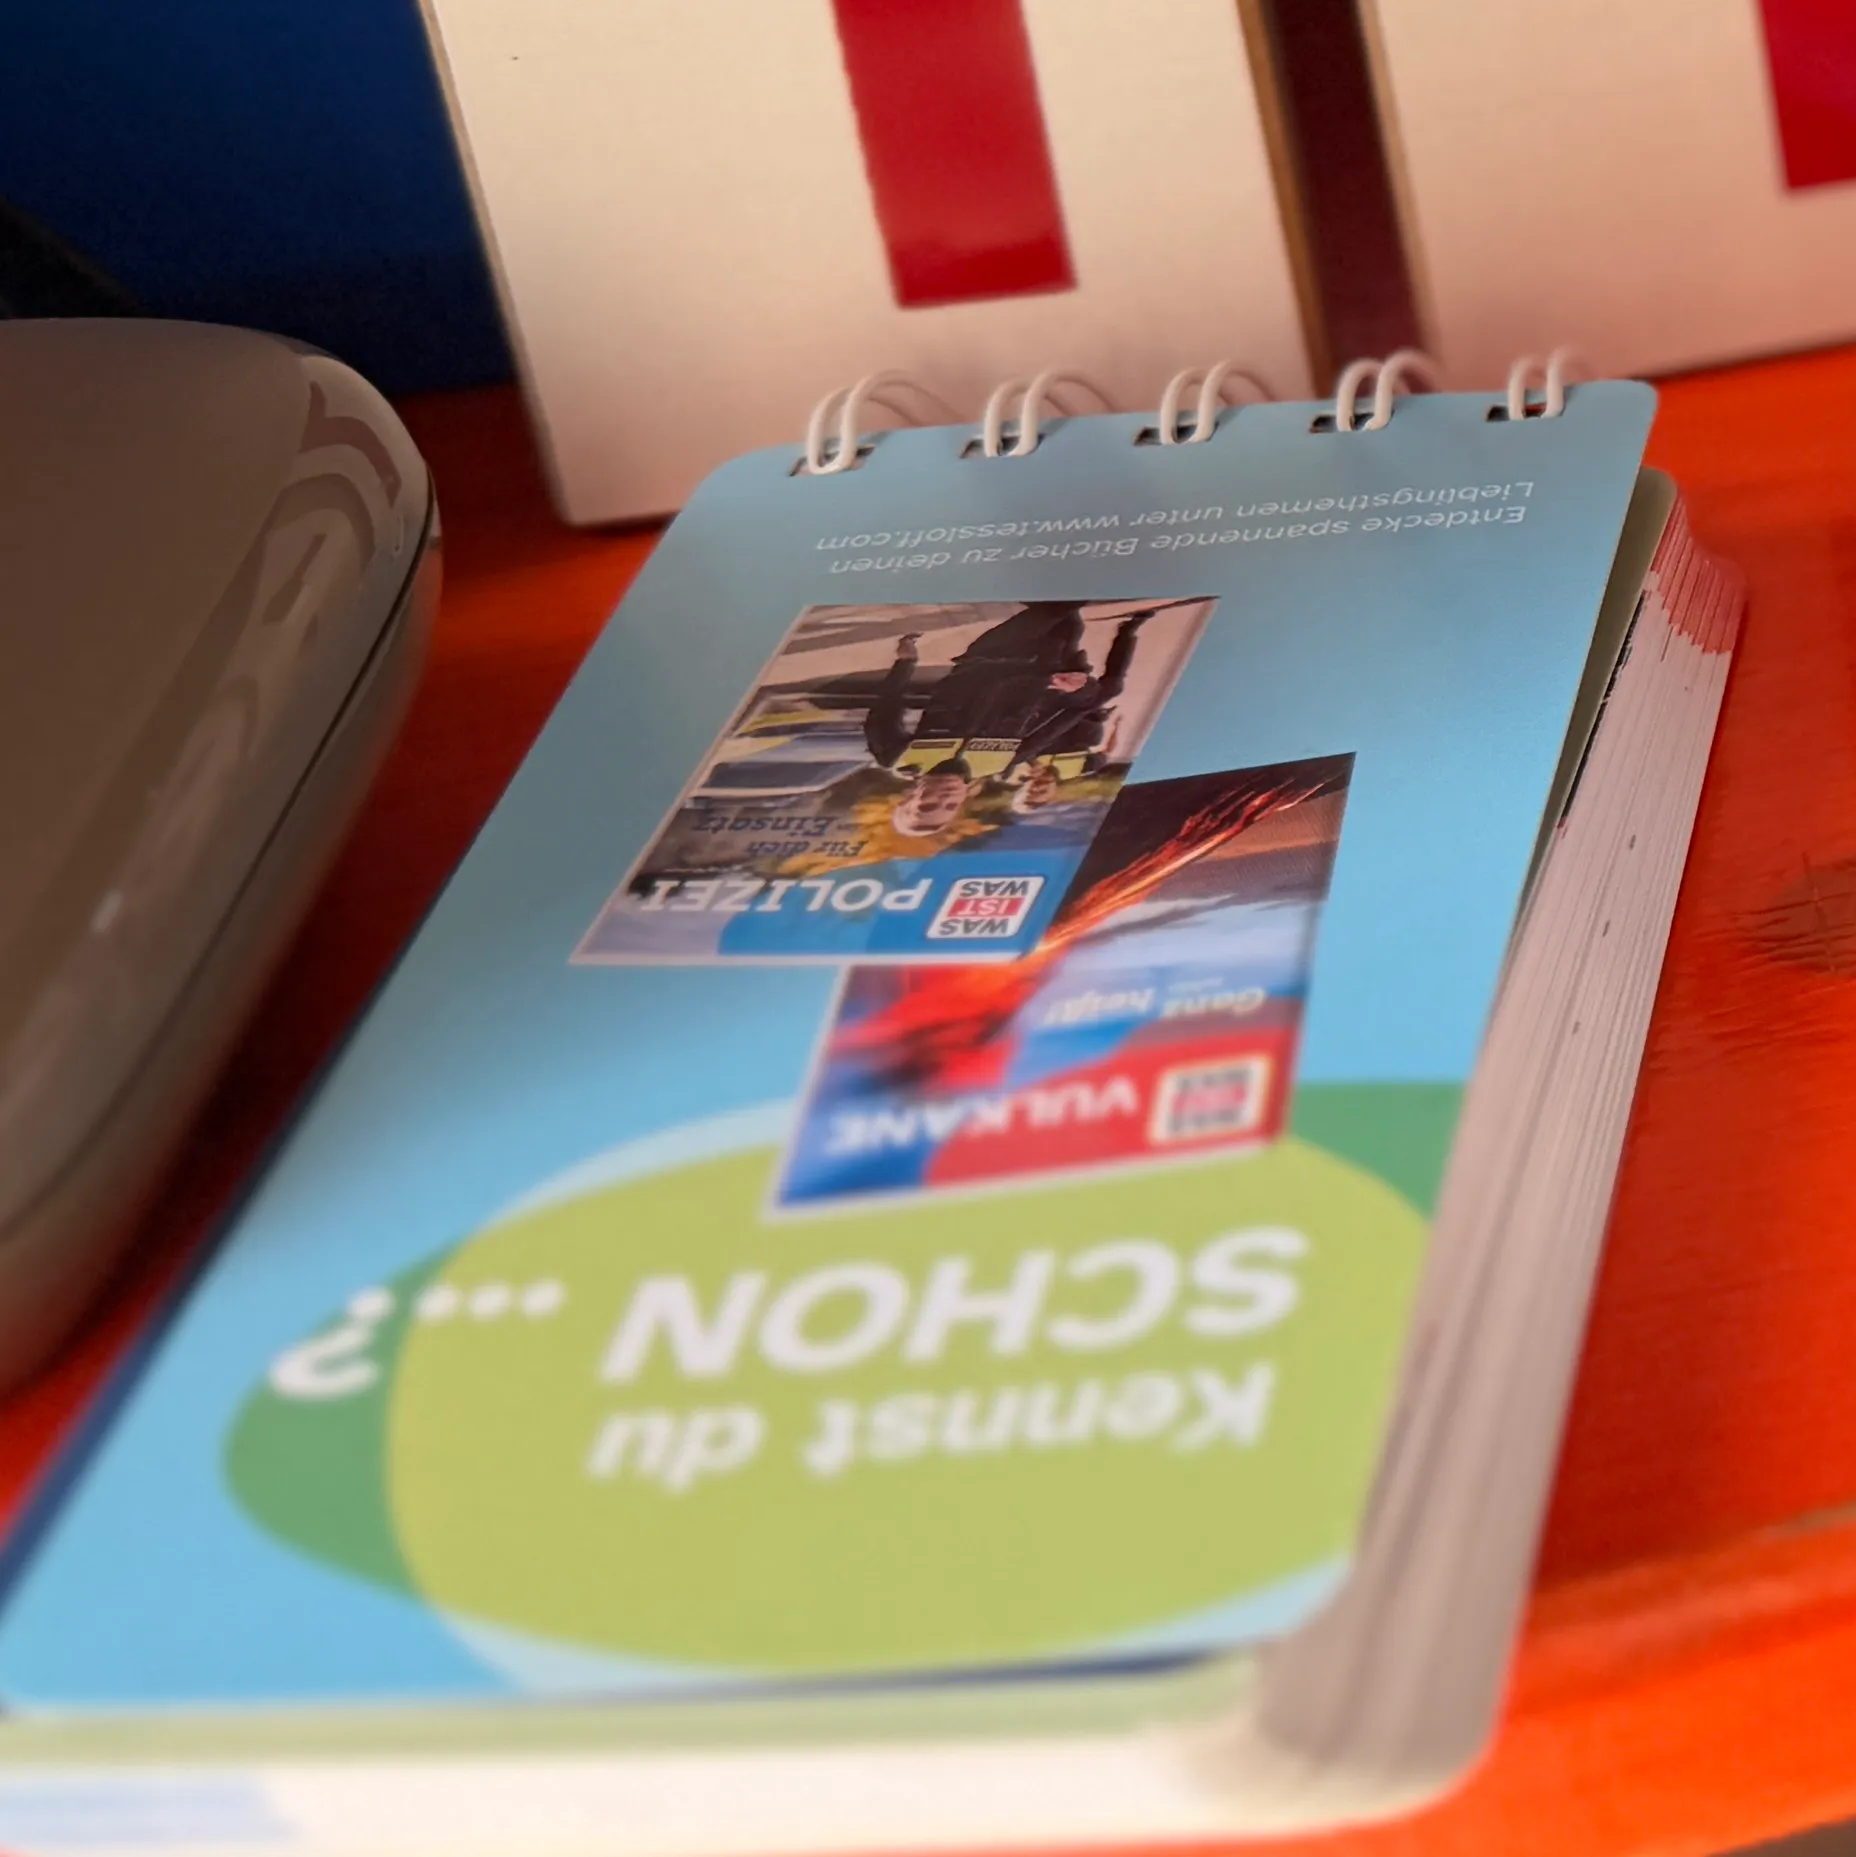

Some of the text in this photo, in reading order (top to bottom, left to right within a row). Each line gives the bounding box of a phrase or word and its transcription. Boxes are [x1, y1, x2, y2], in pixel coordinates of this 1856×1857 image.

[817, 480, 1536, 551] Lieblingsthemen unter www.tessloff.com
[829, 505, 1528, 575] Entdecke spannende Bücher zu deinen
[692, 814, 842, 837] Einsatz
[637, 877, 934, 913] POLIZEI
[951, 898, 1015, 917] IST
[959, 879, 1032, 898] WAS
[937, 917, 1010, 937] WAS
[824, 1076, 1139, 1158] VULKANE
[595, 1222, 1311, 1388] SCHON
[584, 1358, 1278, 1494] Kennst du
